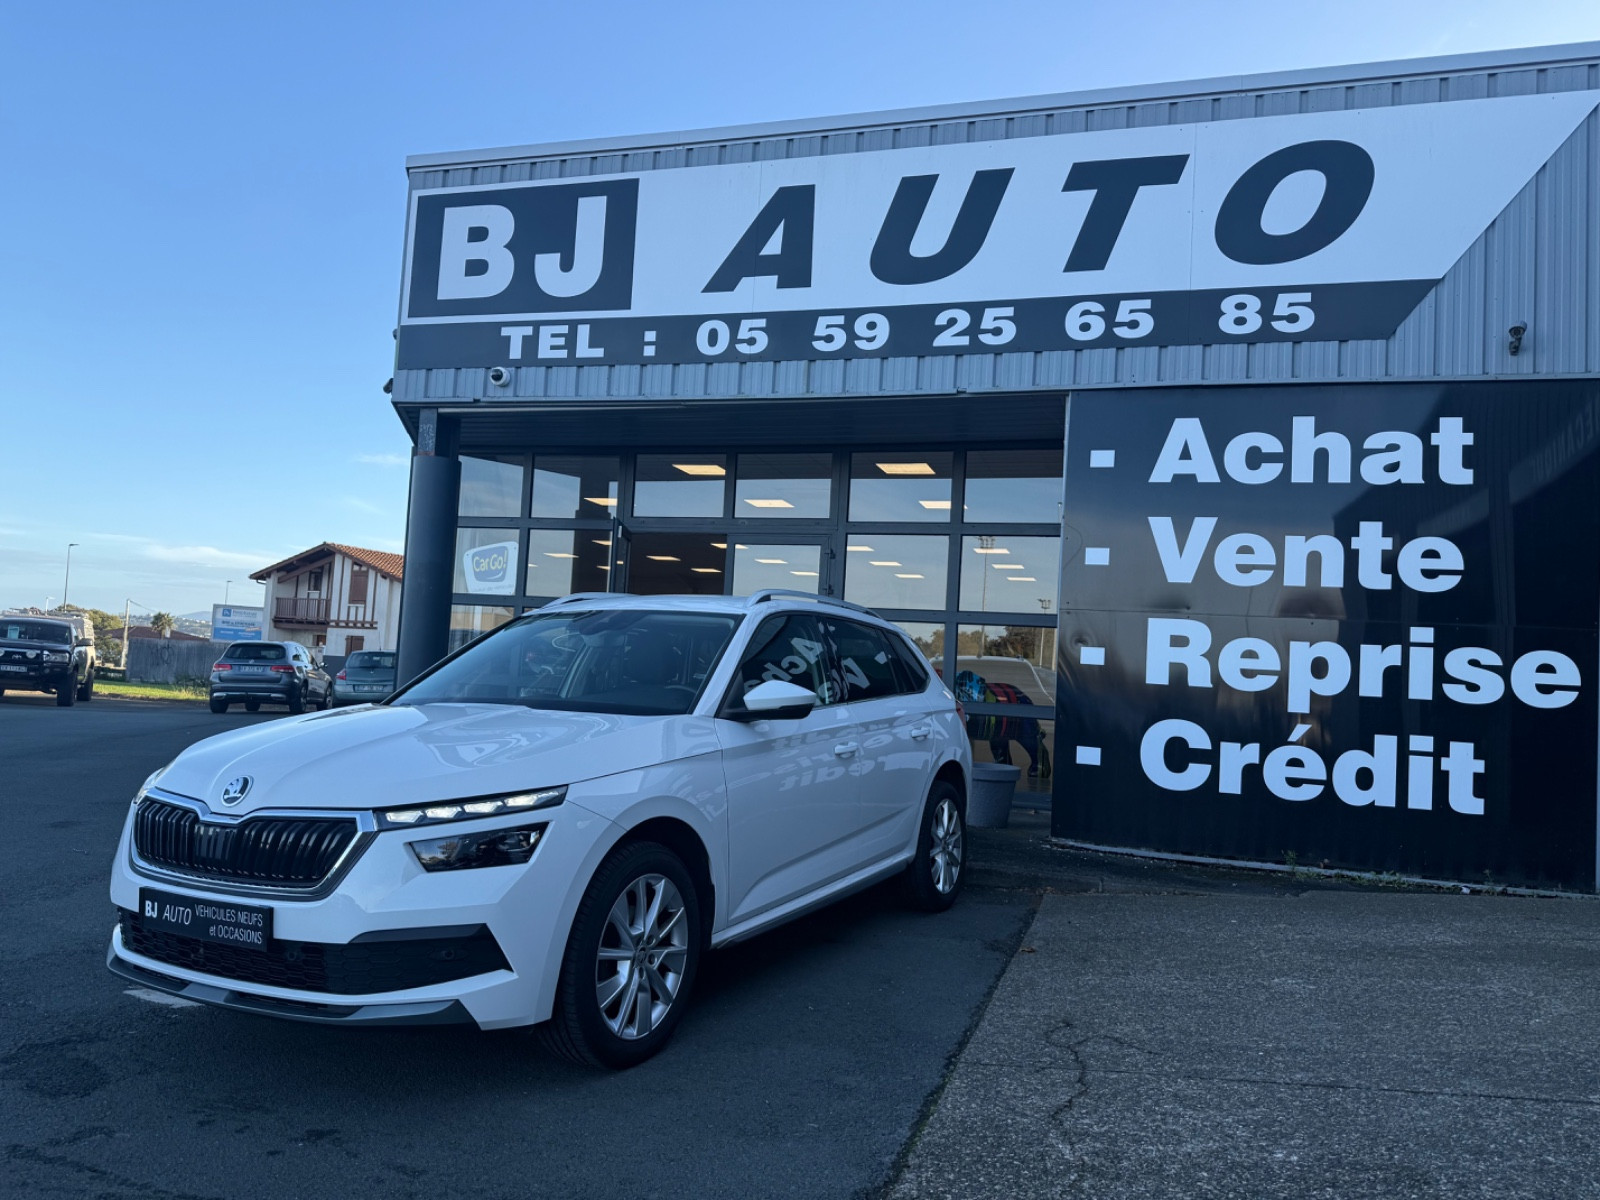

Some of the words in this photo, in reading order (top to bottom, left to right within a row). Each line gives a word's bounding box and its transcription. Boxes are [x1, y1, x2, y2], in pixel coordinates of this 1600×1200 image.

[437, 196, 607, 300] BJ
[701, 140, 1375, 293] AUTO
[501, 324, 604, 359] TEL
[642, 330, 657, 357] :
[696, 319, 768, 355] 05
[812, 313, 890, 351] 59
[932, 307, 1017, 346] 25
[1065, 299, 1154, 340] 65
[1218, 293, 1315, 334] 85
[1148, 416, 1474, 485] Achat
[1147, 517, 1465, 593] Vente
[1145, 618, 1582, 714] Reprise
[1140, 719, 1485, 815] Crédit
[145, 900, 158, 918] BJ
[163, 904, 192, 925] AUTO
[195, 904, 236, 923] VEHICULES
[238, 911, 263, 927] NEUFS
[209, 924, 217, 936] et
[217, 924, 262, 944] OCCASIONS
